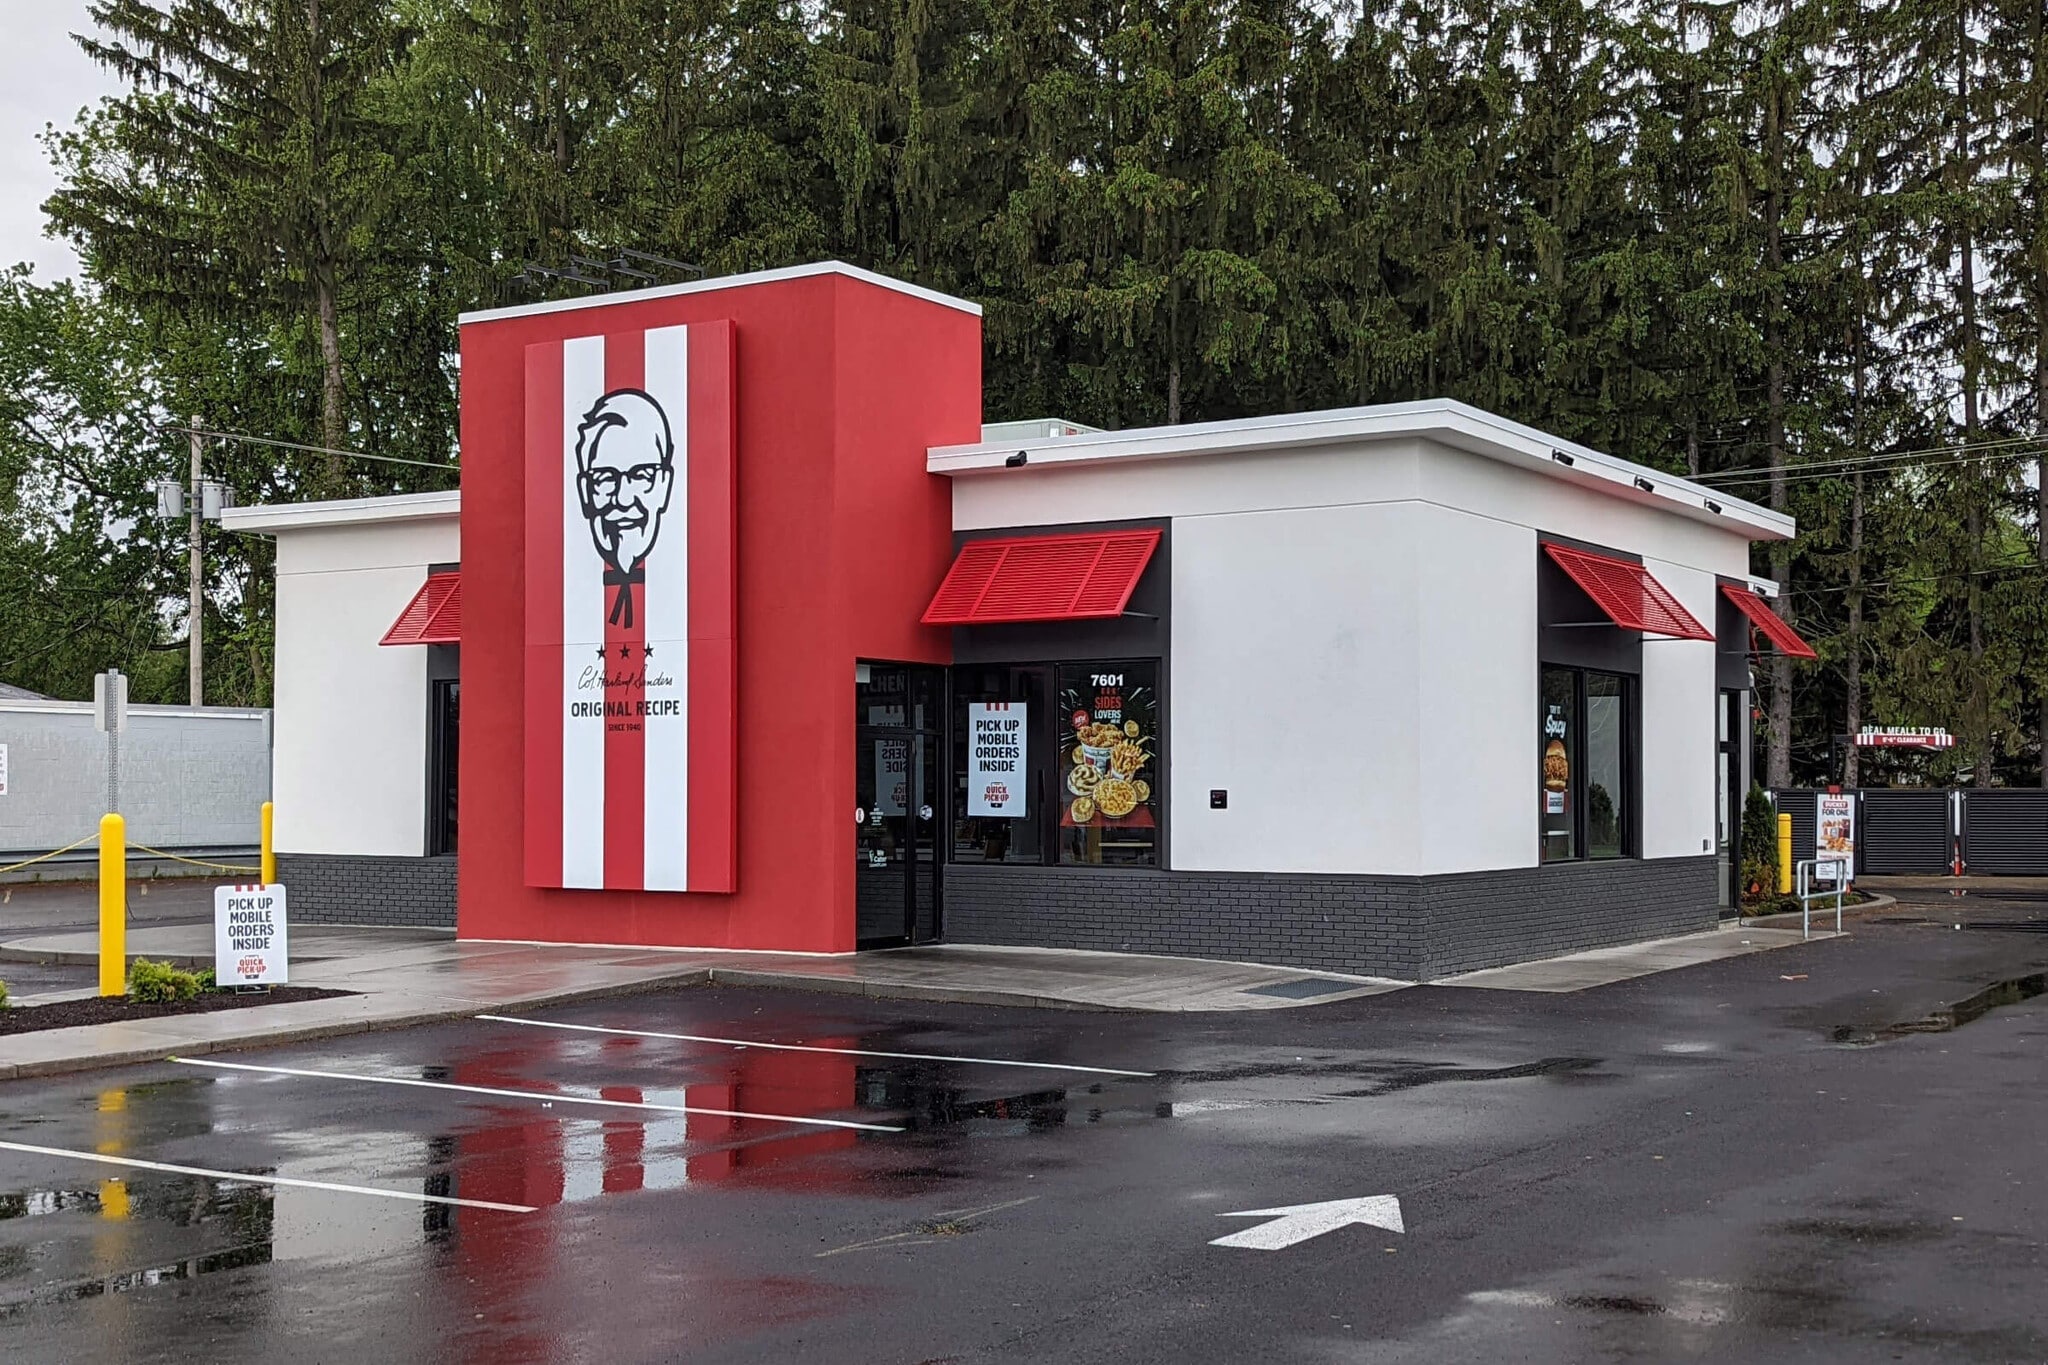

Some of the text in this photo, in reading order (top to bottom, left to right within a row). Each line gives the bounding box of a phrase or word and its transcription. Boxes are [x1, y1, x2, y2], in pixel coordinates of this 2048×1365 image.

[1090, 674, 1124, 687] 7601
[571, 700, 680, 717] ORIGINAL RECIPE
[1094, 696, 1122, 709] SIDES
[1094, 710, 1122, 719] LOVERS
[976, 719, 1019, 732] PICK UP
[1862, 725, 1946, 736] REAL MEALS TO GO
[978, 733, 1018, 745] MOBILE
[976, 747, 1020, 758] ORDERS
[979, 760, 1015, 772] INSIDE
[986, 786, 1007, 794] QUICK
[1822, 808, 1849, 816] FOR ONE
[228, 897, 273, 910] PICK UP
[230, 910, 272, 924] MOBILE
[228, 924, 274, 937] ORDERS
[233, 937, 271, 950] INSIDE
[239, 958, 264, 967] QUICK
